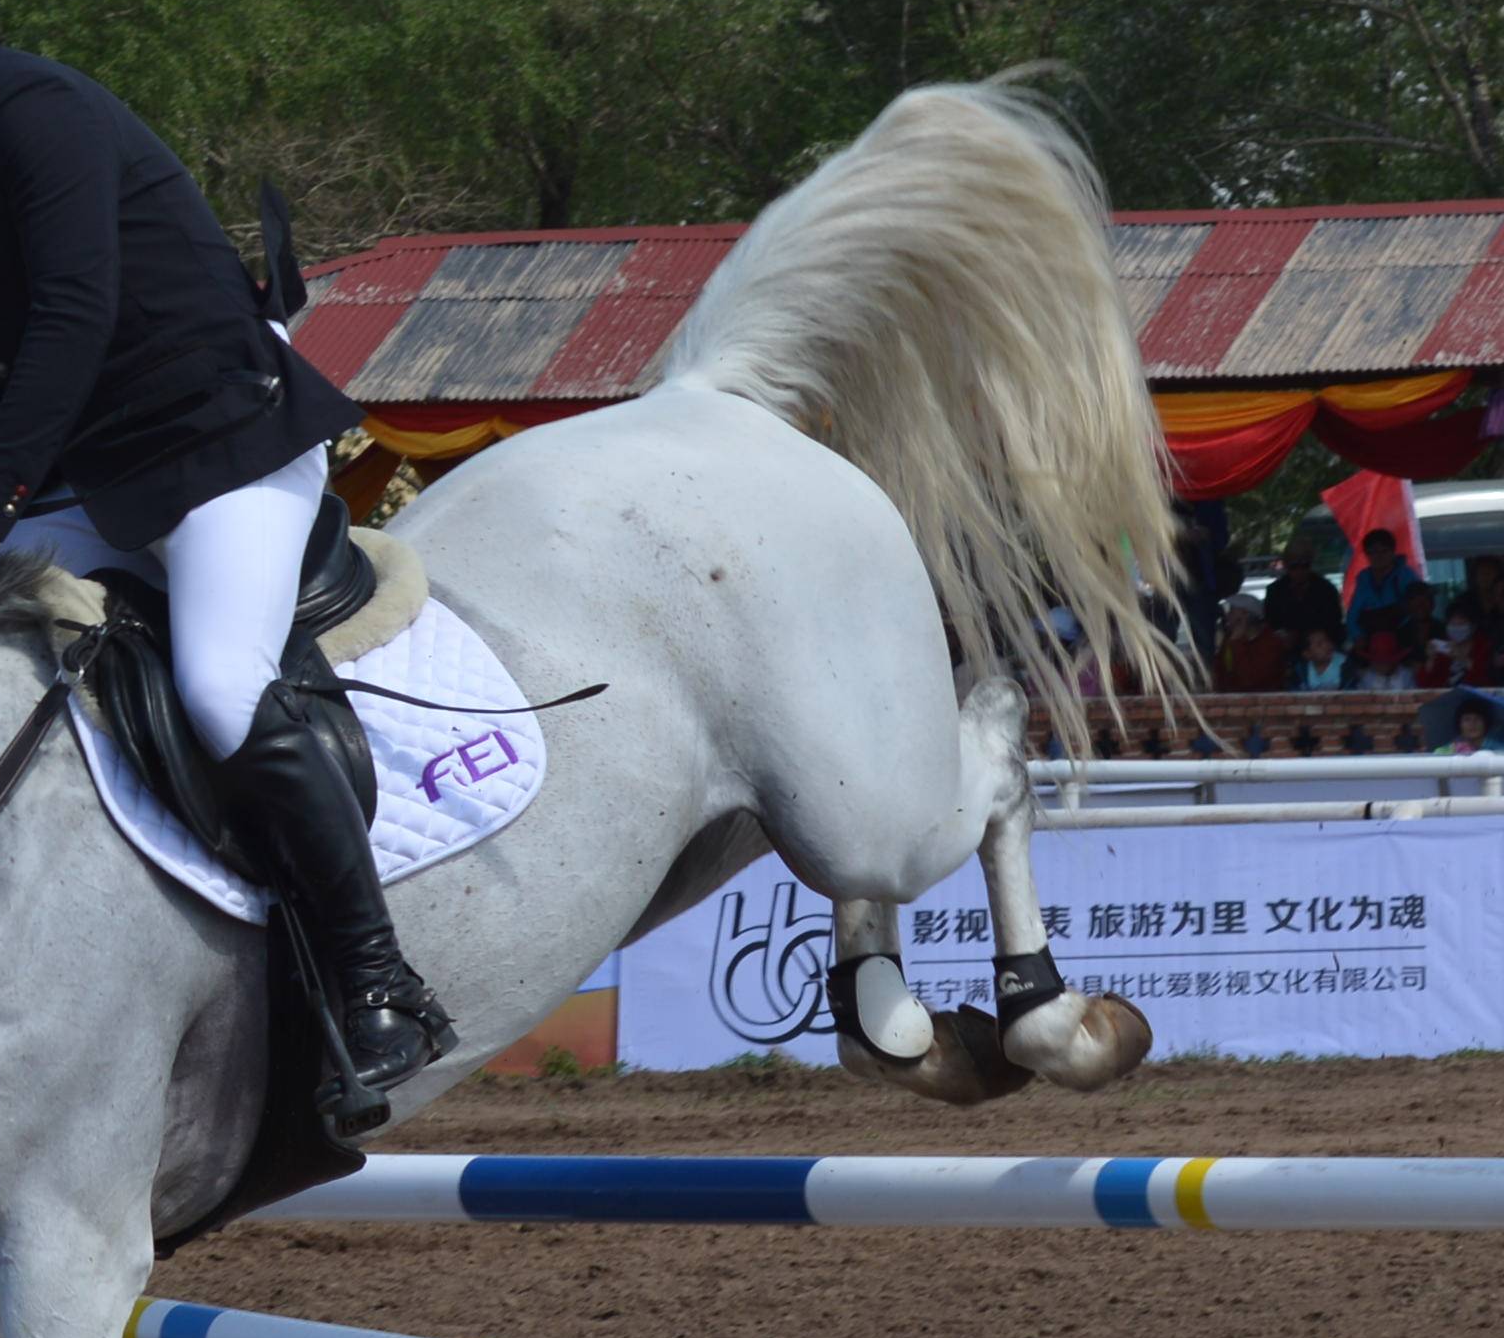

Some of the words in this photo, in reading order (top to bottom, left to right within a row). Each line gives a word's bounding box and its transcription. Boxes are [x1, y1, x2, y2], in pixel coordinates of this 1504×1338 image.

[416, 730, 519, 803] FEI
[912, 905, 1072, 945] 影视表
[1088, 900, 1248, 939] 旅游为里
[1265, 894, 1427, 932] 文化为魂
